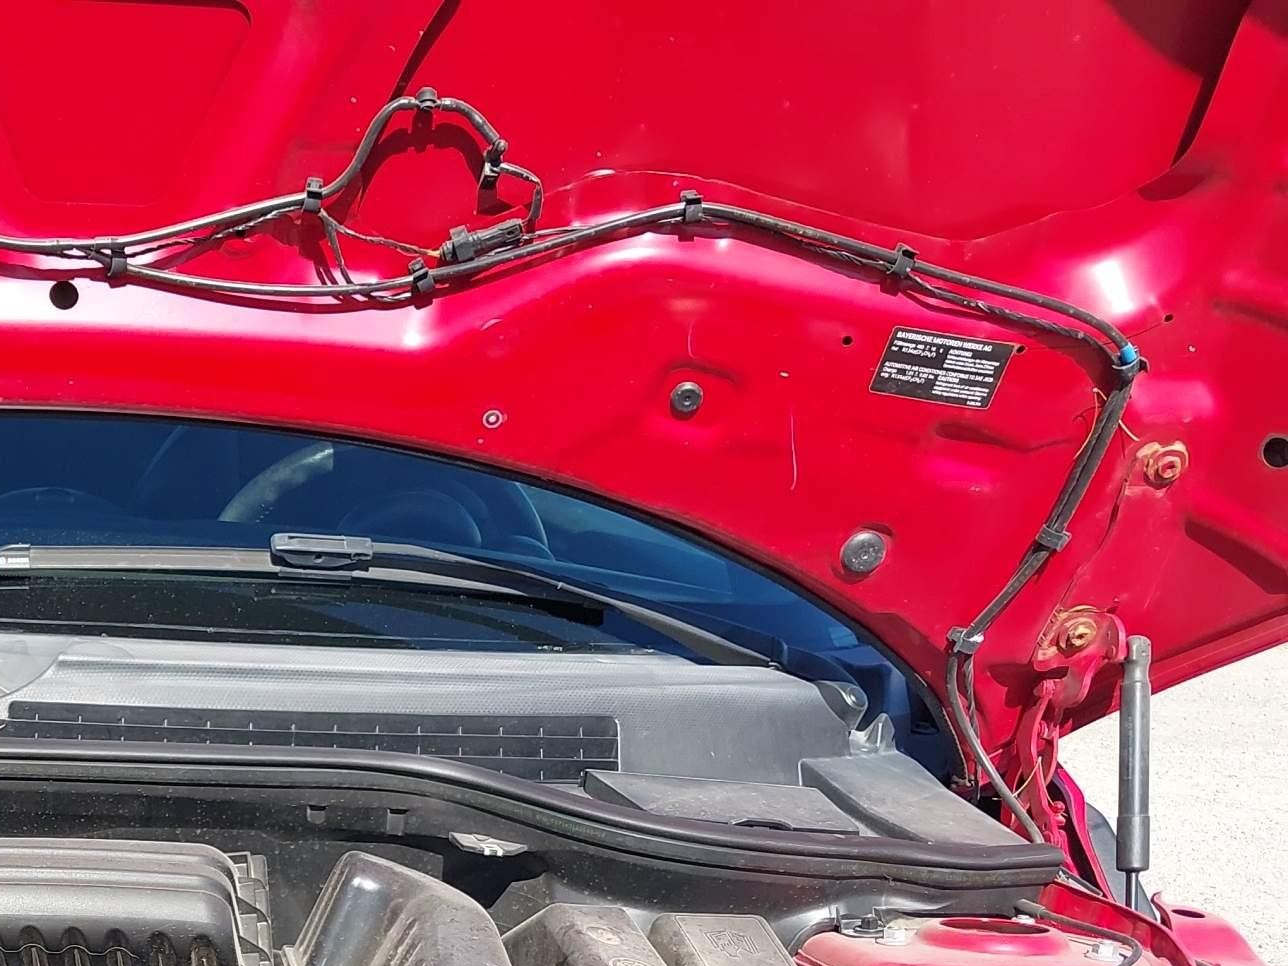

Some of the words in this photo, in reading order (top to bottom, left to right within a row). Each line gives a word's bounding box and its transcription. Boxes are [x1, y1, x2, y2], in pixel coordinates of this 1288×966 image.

[896, 331, 933, 343] BAYERISCHE
[932, 337, 963, 347] MOTOREN
[962, 342, 984, 351] WERKE
